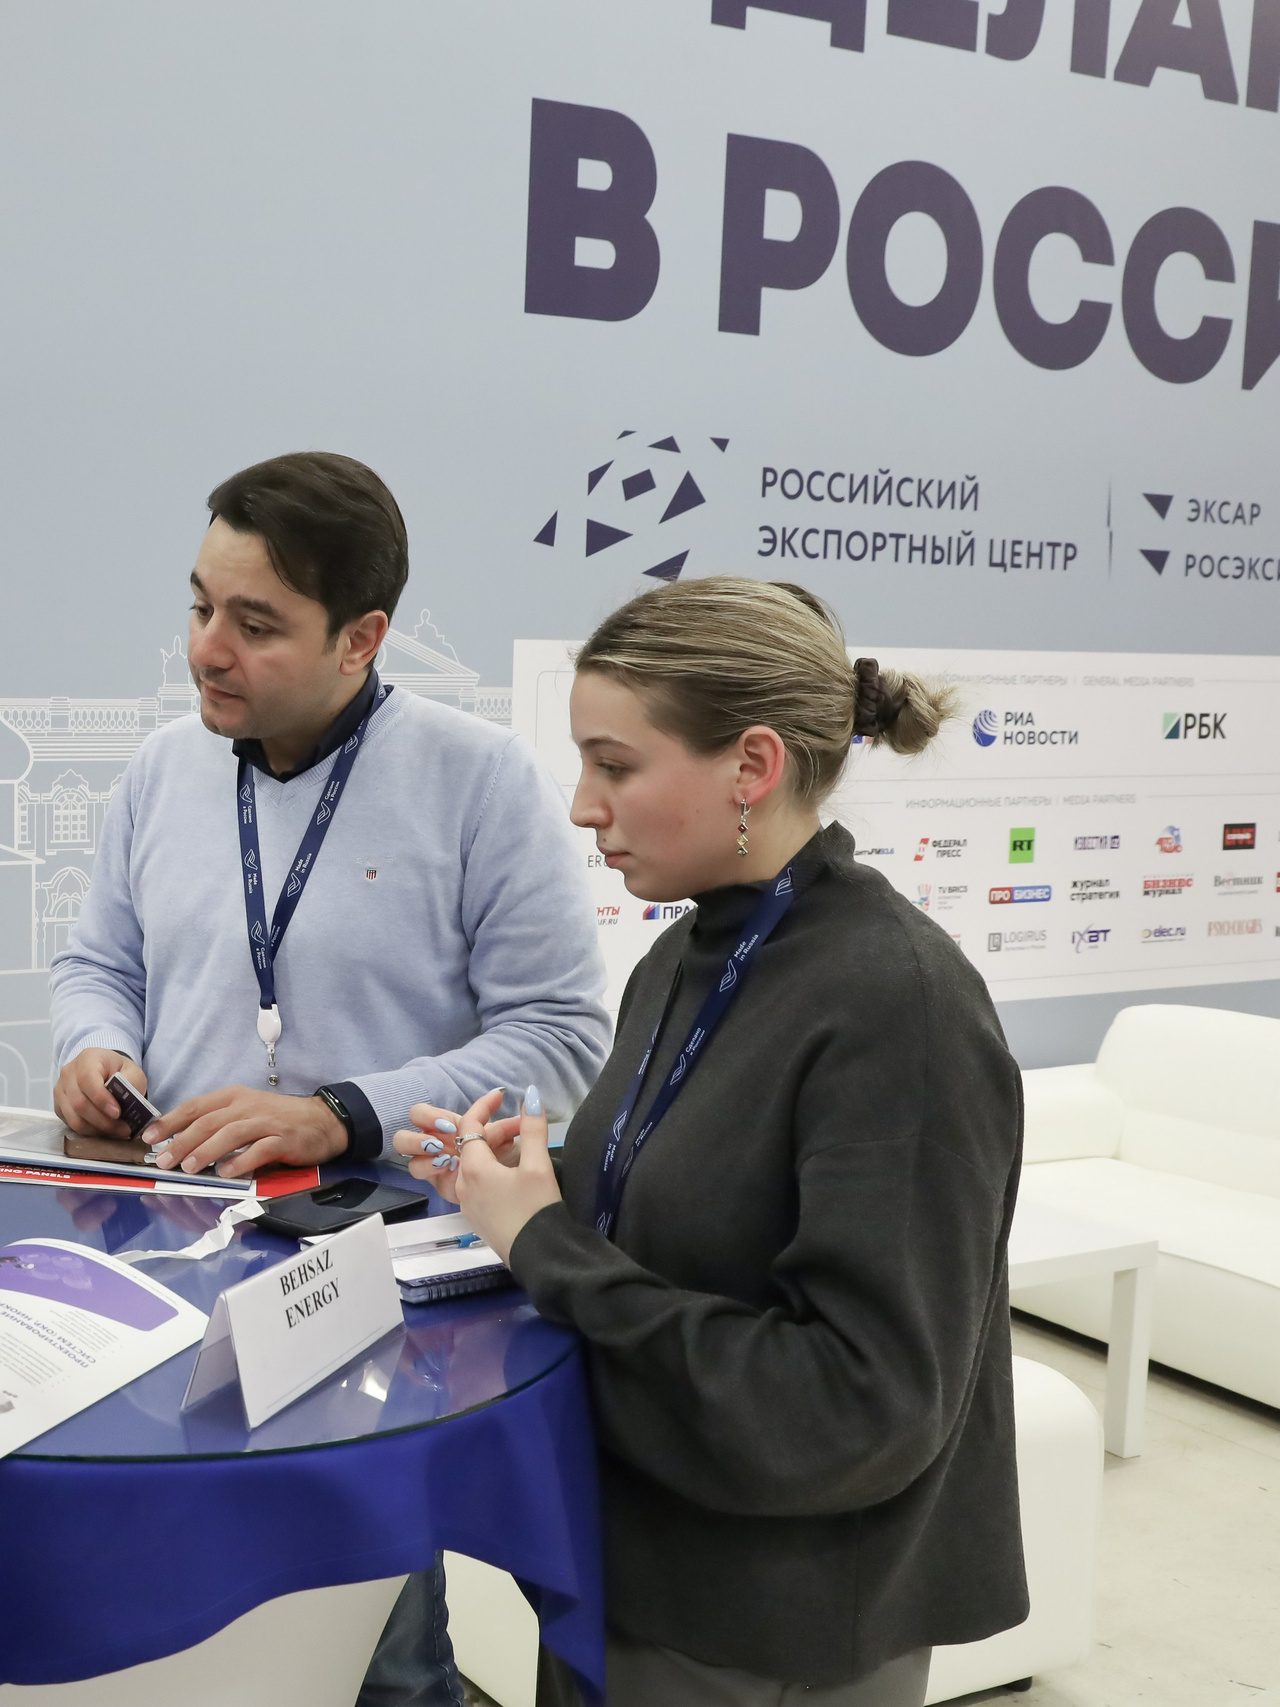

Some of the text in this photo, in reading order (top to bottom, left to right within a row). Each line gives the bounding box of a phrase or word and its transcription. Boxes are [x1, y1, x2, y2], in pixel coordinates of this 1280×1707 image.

[524, 97, 661, 323] В
[761, 467, 980, 511] РОССИЙСКИЙ
[1187, 498, 1261, 526] ЭКСАР
[757, 526, 1078, 573] ЭКСПОРТНЫЙ ЦЕНТР
[1185, 553, 1280, 581] РОСЭКС
[1004, 712, 1035, 726] РИА
[1183, 712, 1227, 739] РБК
[1003, 730, 1079, 745] НОВОСТИ
[905, 797, 1001, 809] ИНФОРМАЦИОННЫЕ
[932, 838, 968, 849] ФЕДЕРАЛ
[1012, 839, 1034, 851] RT
[302, 852, 313, 869] Russia
[936, 849, 962, 858] ПРЕСС
[295, 857, 304, 872] Made
[1071, 879, 1110, 891] журнал
[1143, 878, 1193, 889] БИЗНЕС
[991, 888, 1050, 902] ПРО БИЗНЕС
[1071, 890, 1120, 902] стратегия
[1004, 930, 1047, 944] LOGIRUS
[1154, 925, 1186, 937] elec.ru
[734, 941, 747, 958] Made
[739, 934, 759, 961] in Russia
[25, 1170, 71, 1179] PANELS
[279, 1249, 334, 1297] BEHSAZ
[284, 1277, 341, 1329] ENERGY
[0, 1311, 90, 1368] ПРОЕКТИРОВАНИЕ
[56, 1336, 96, 1364] СИСТЕМ
